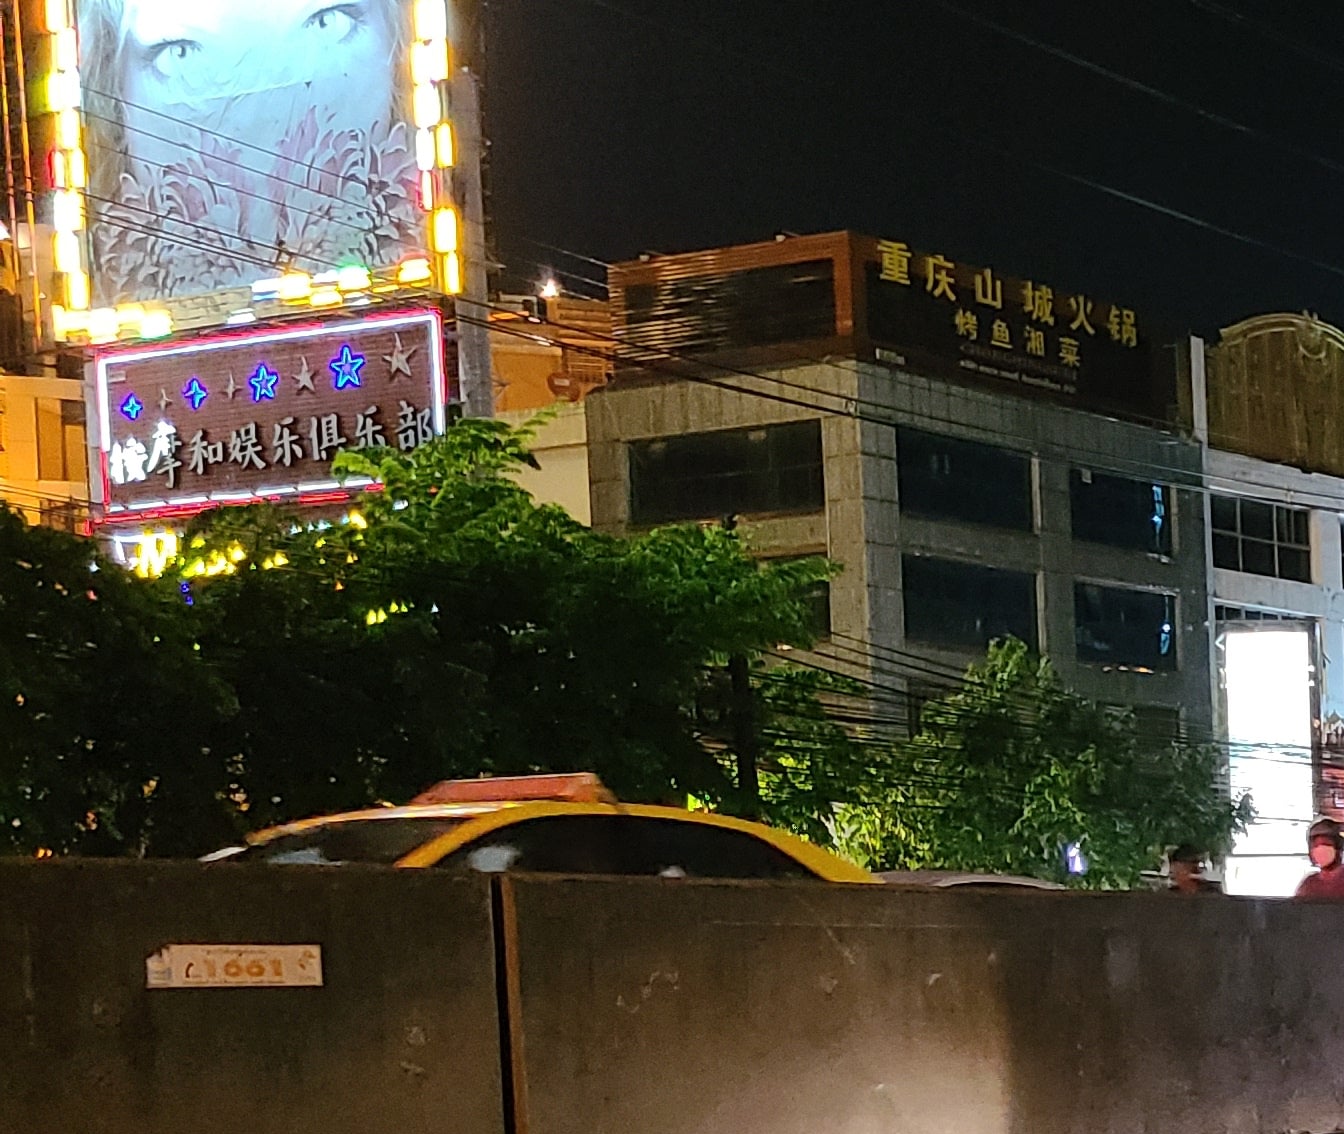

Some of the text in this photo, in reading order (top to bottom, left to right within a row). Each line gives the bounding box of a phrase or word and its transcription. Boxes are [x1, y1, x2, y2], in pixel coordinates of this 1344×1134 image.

[877, 239, 1139, 348] 重庆山城火锅
[954, 307, 1081, 368] 烤鱼湘菜
[110, 400, 435, 489] 按摩和娱乐俱乐部
[204, 958, 284, 978] 1661
